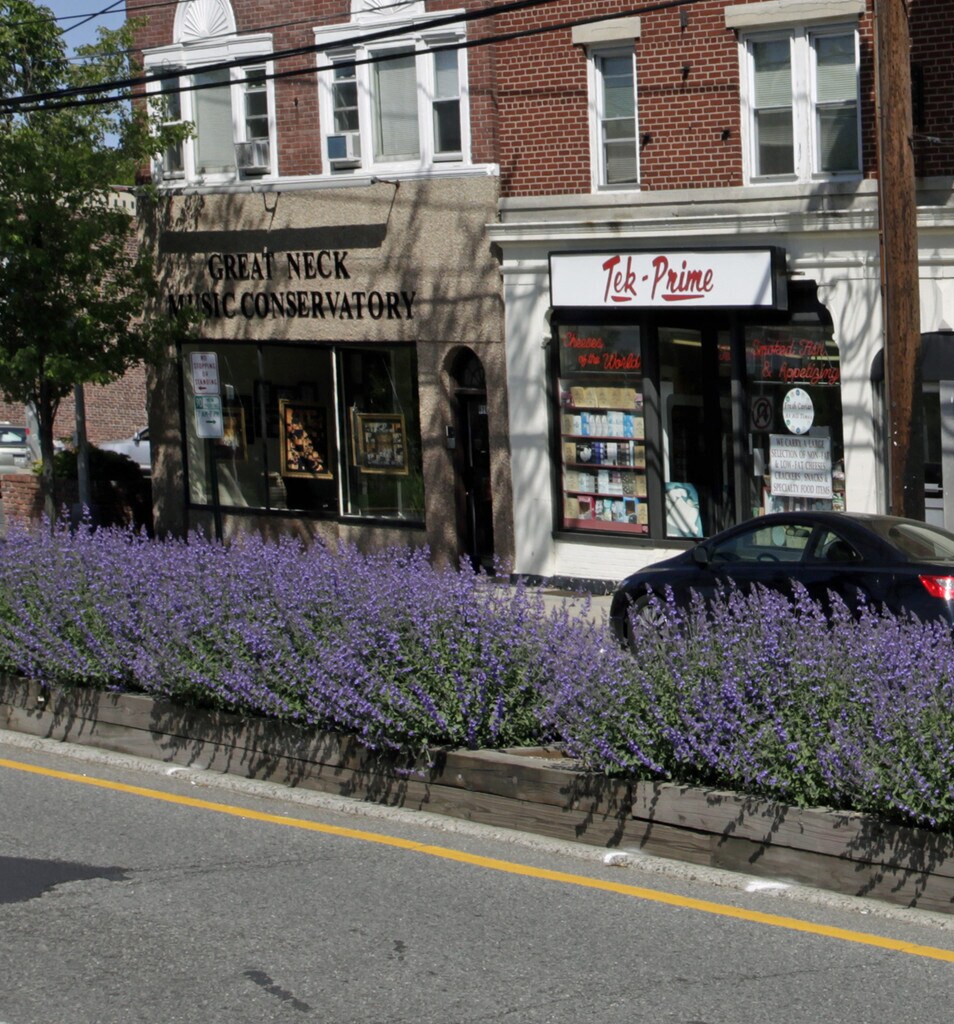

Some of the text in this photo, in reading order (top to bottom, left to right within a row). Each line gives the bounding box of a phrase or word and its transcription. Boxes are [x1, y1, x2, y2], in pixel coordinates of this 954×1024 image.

[208, 250, 351, 281] GREAT NECK
[240, 291, 416, 320] CONSERVATORY
[602, 352, 641, 369] World
[762, 361, 839, 384] & Appetizing
